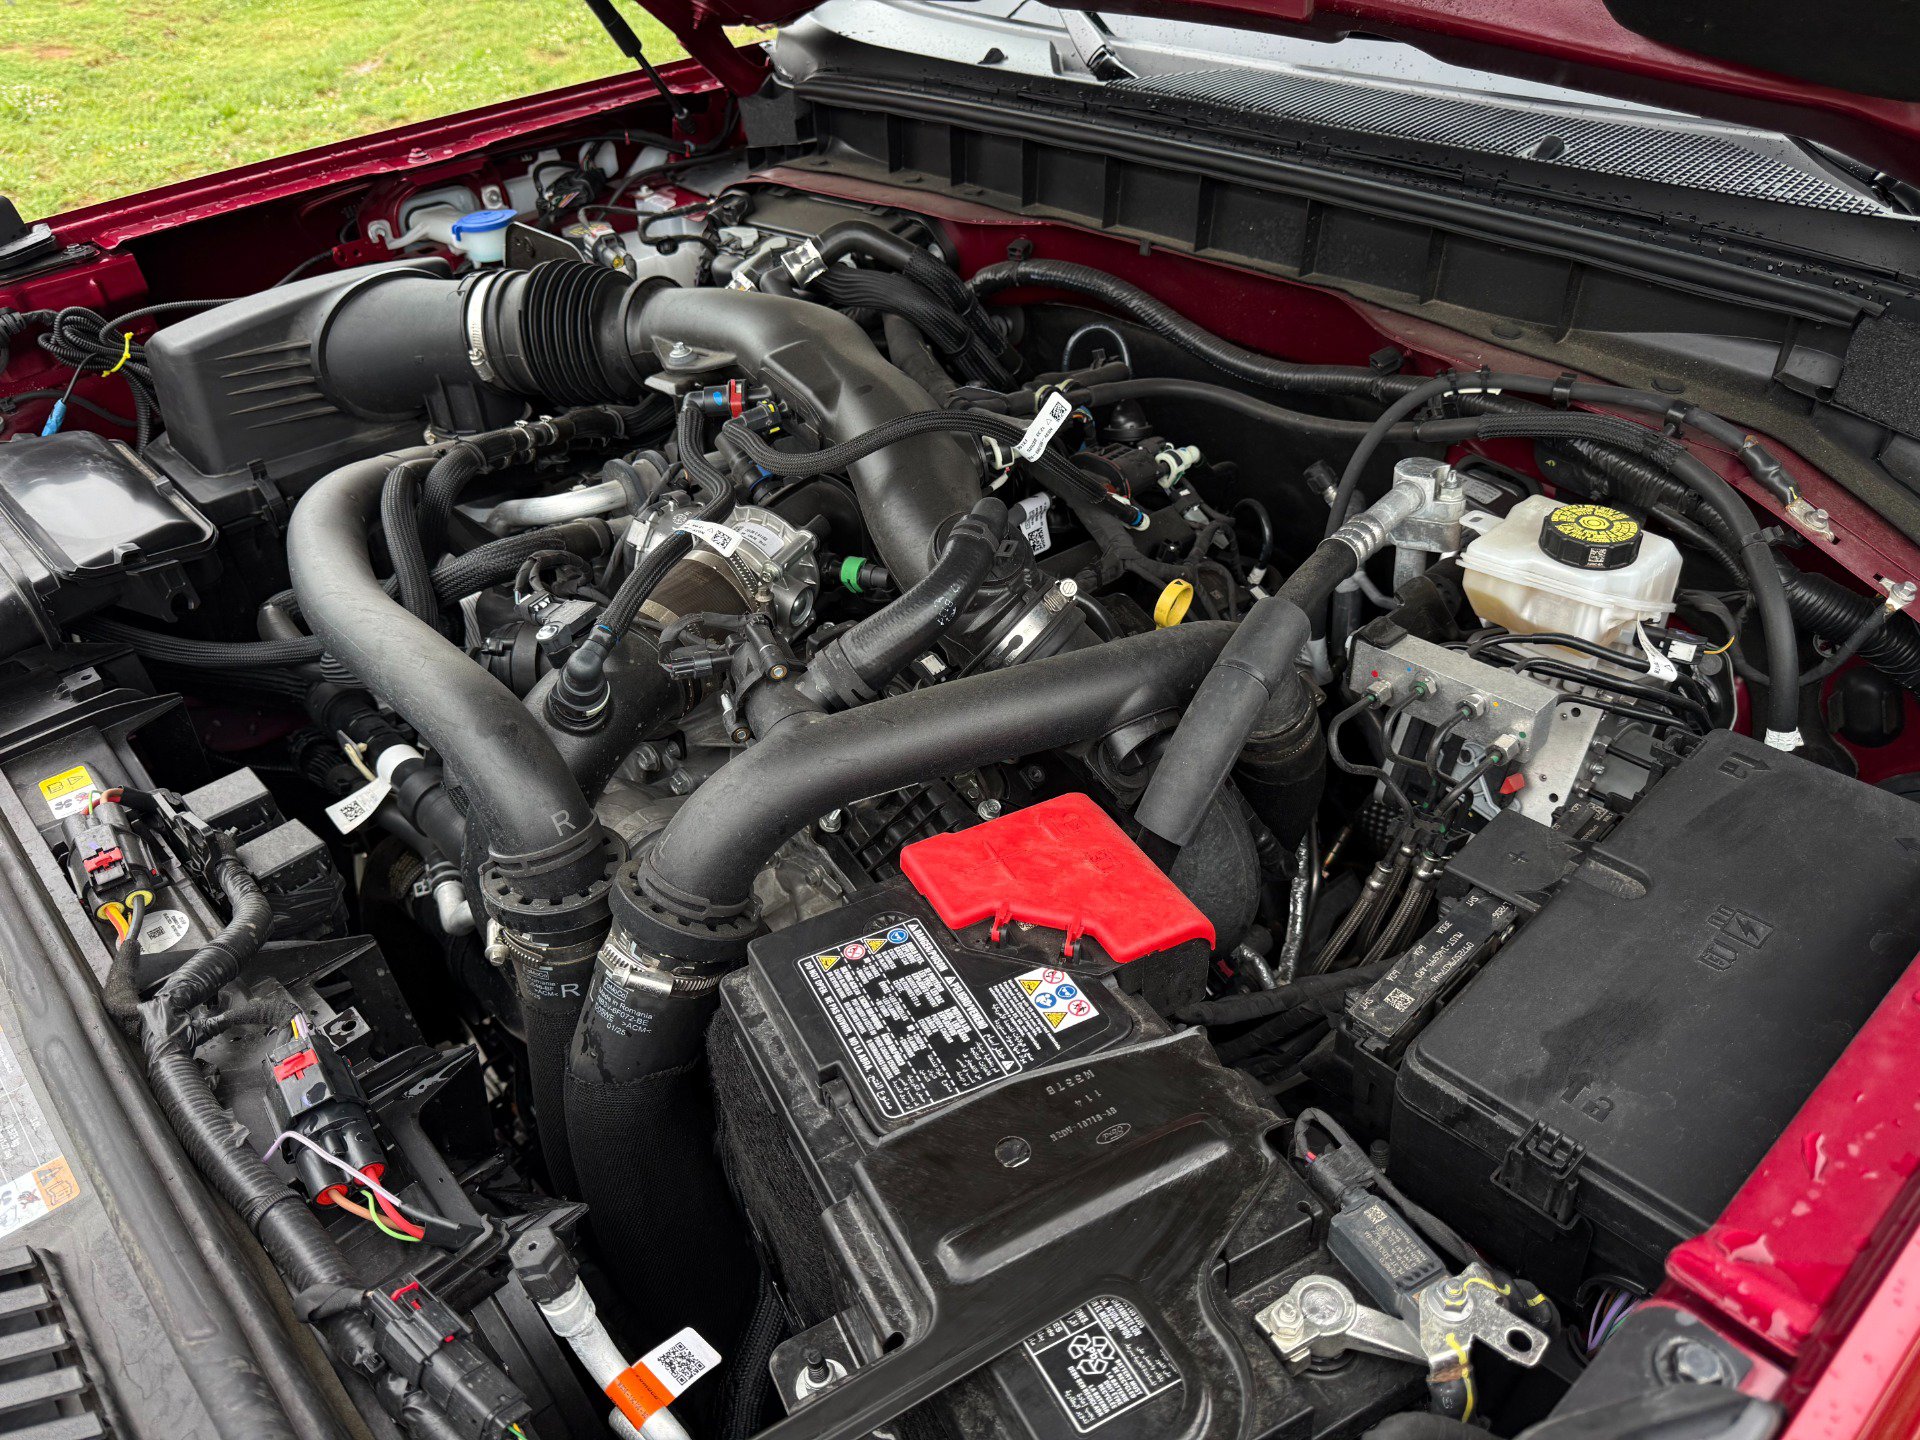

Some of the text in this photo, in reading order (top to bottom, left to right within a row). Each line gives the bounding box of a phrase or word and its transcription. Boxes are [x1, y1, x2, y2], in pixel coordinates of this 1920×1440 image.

[550, 809, 576, 836] R
[559, 981, 582, 1000] R
[912, 928, 948, 971] DANGER/POISON
[949, 981, 988, 1030] PELIGRO/VENENO
[598, 986, 653, 1020] Made in Romania
[803, 960, 874, 1072] DO NOT OPEN. NE PAS OUVRIR. NO LA ABRA.
[606, 1022, 626, 1036] 01/25
[1101, 1124, 1125, 1141] Ford
[1094, 1304, 1117, 1332] EL MÉDICO.
[1104, 1303, 1133, 1339] ACUDA RÁPIDO
[1084, 1345, 1100, 1361] Pb
[1067, 1365, 1104, 1417] DEBE SER RECICLADA
[1087, 1383, 1097, 1393] LA
[1102, 1379, 1115, 1393] DOIT
[1105, 1371, 1129, 1402] LA BATTERIE
[1111, 1366, 1137, 1399] BE RECYCLED
[1114, 1358, 1143, 1395] BATTERY MUST
